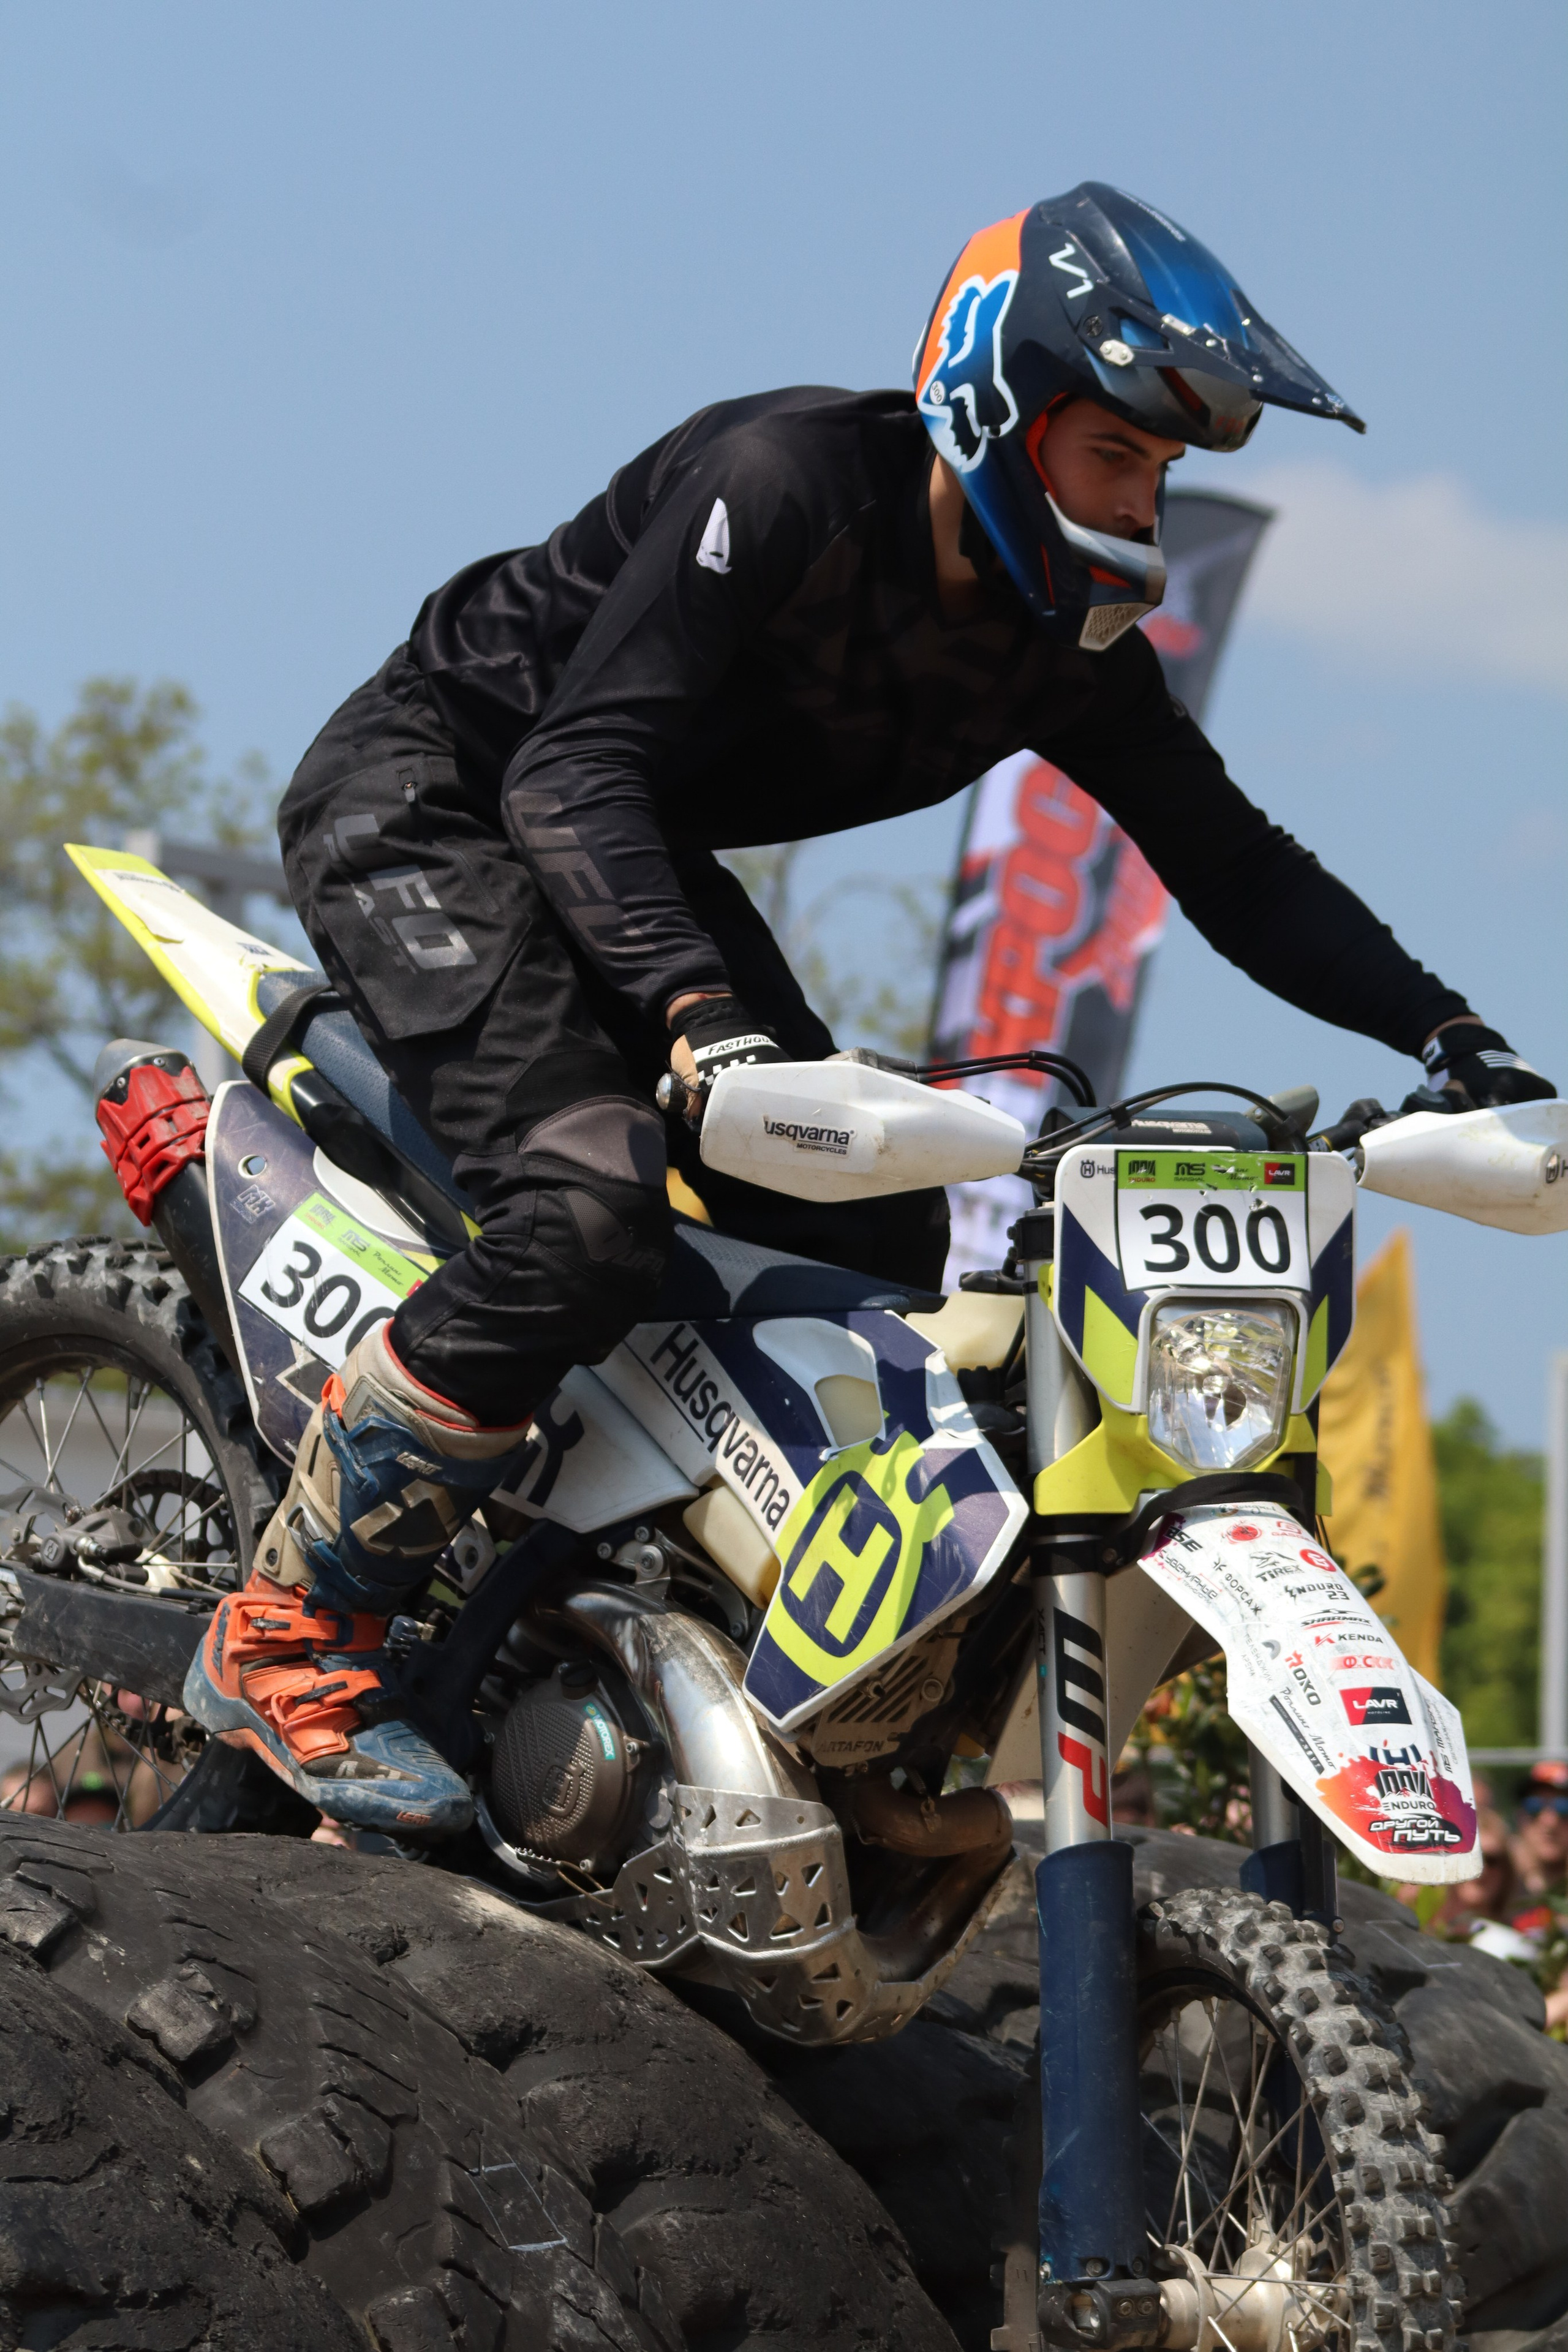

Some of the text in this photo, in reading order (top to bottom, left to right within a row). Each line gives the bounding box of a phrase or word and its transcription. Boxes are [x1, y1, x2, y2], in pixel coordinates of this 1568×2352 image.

[931, 383, 944, 403] 300
[323, 833, 419, 974] PAST
[707, 1035, 776, 1056] FASTHOU
[796, 1143, 847, 1155] MOTORCYCLES
[1139, 1204, 1291, 1274] 300
[650, 1323, 791, 1532] Husqvarna
[1224, 1573, 1262, 1616] ФОРСАЖ
[1325, 1591, 1350, 1600] 23
[1300, 1616, 1371, 1627] SHARMAX
[1338, 1634, 1384, 1643] KENDA
[1352, 1699, 1398, 1709] LAVR
[592, 1714, 614, 1757] MOTOREX
[1381, 1801, 1436, 1811] ENDURO
[1370, 1817, 1439, 1832] ДРУГОЙ
[1393, 1829, 1461, 1842] ПУТЬ
